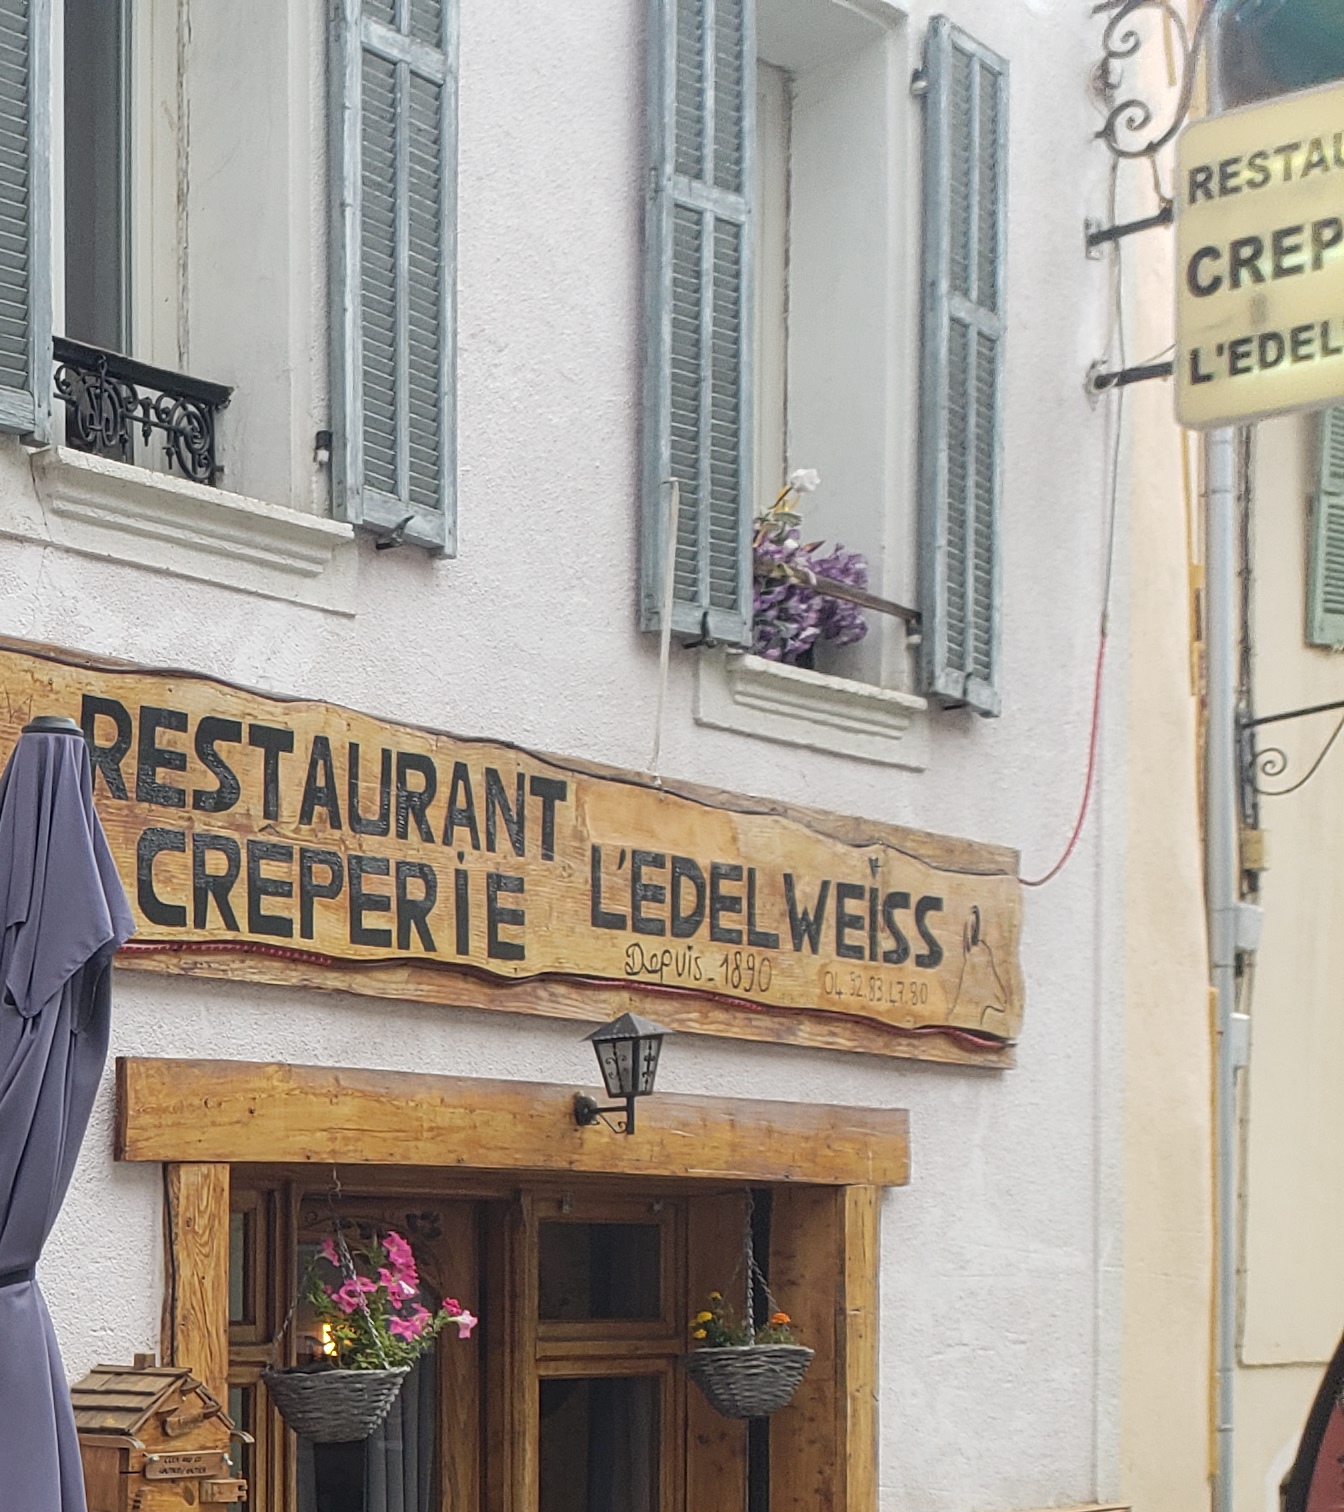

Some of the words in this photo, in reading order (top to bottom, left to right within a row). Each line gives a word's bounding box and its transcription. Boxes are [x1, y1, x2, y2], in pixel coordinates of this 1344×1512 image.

[81, 694, 567, 861] RESTAURANT
[625, 943, 702, 982] Depuis
[720, 951, 772, 992] 1890
